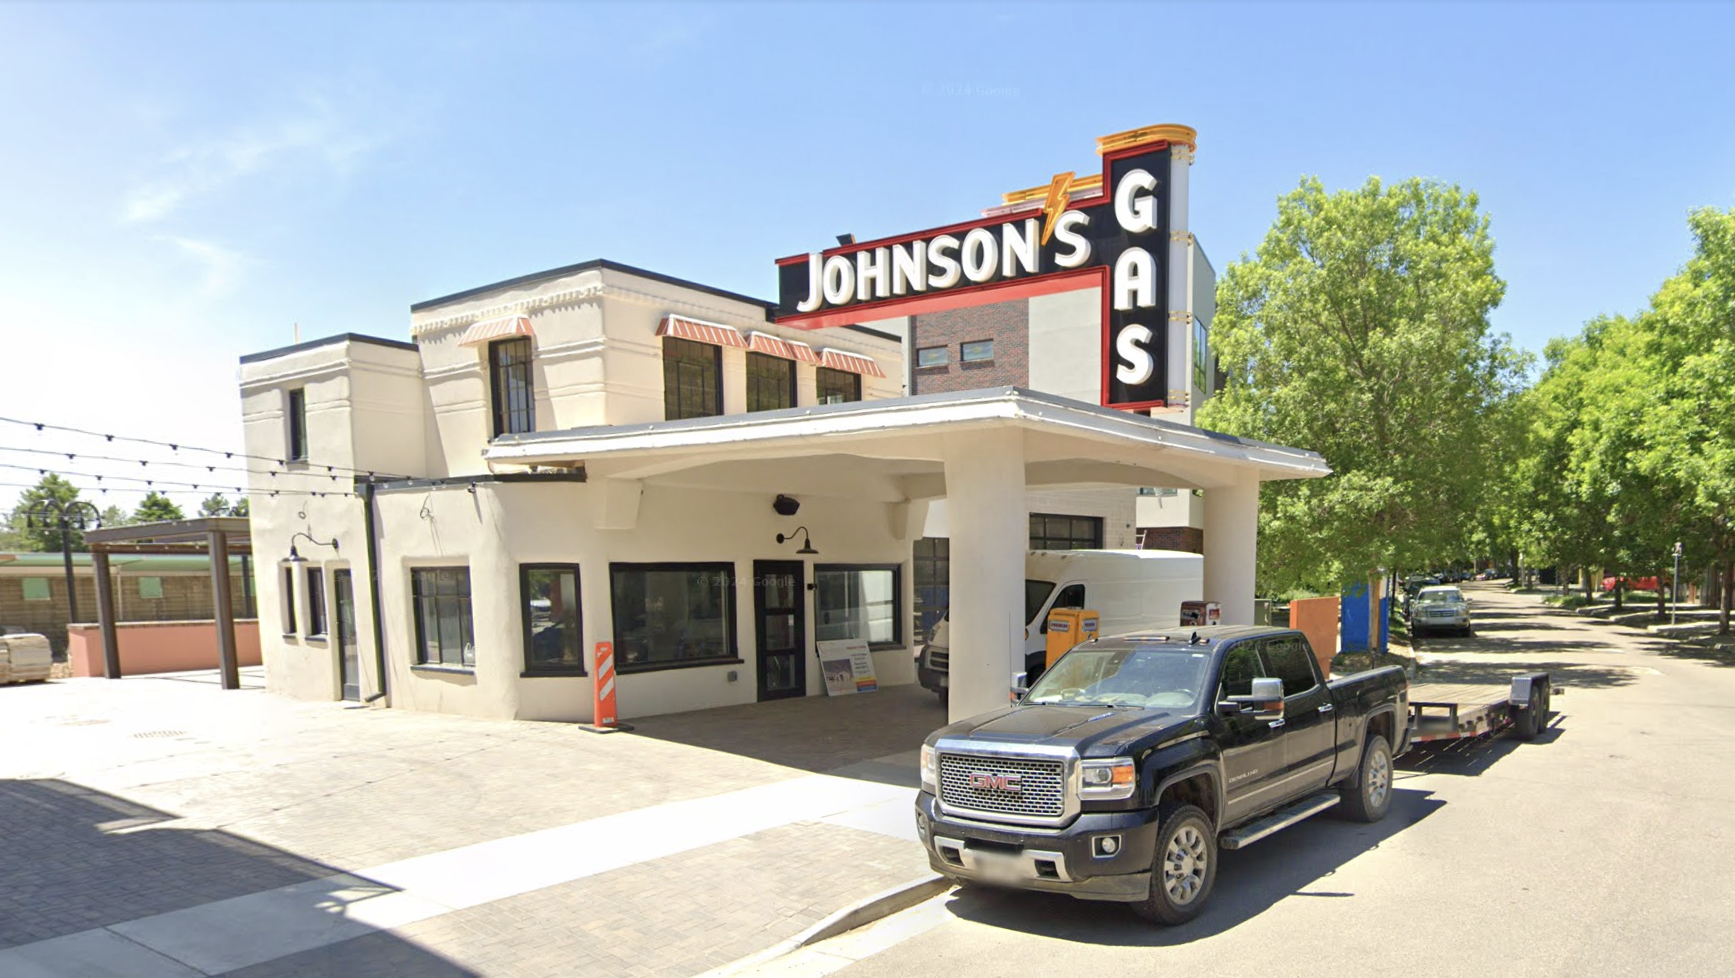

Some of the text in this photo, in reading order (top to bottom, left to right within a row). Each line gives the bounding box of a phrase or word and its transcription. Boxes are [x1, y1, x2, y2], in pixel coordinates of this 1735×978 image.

[797, 171, 1091, 312] JOHNSON'S
[1114, 168, 1158, 385] GAS
[970, 773, 1021, 791] GMC
